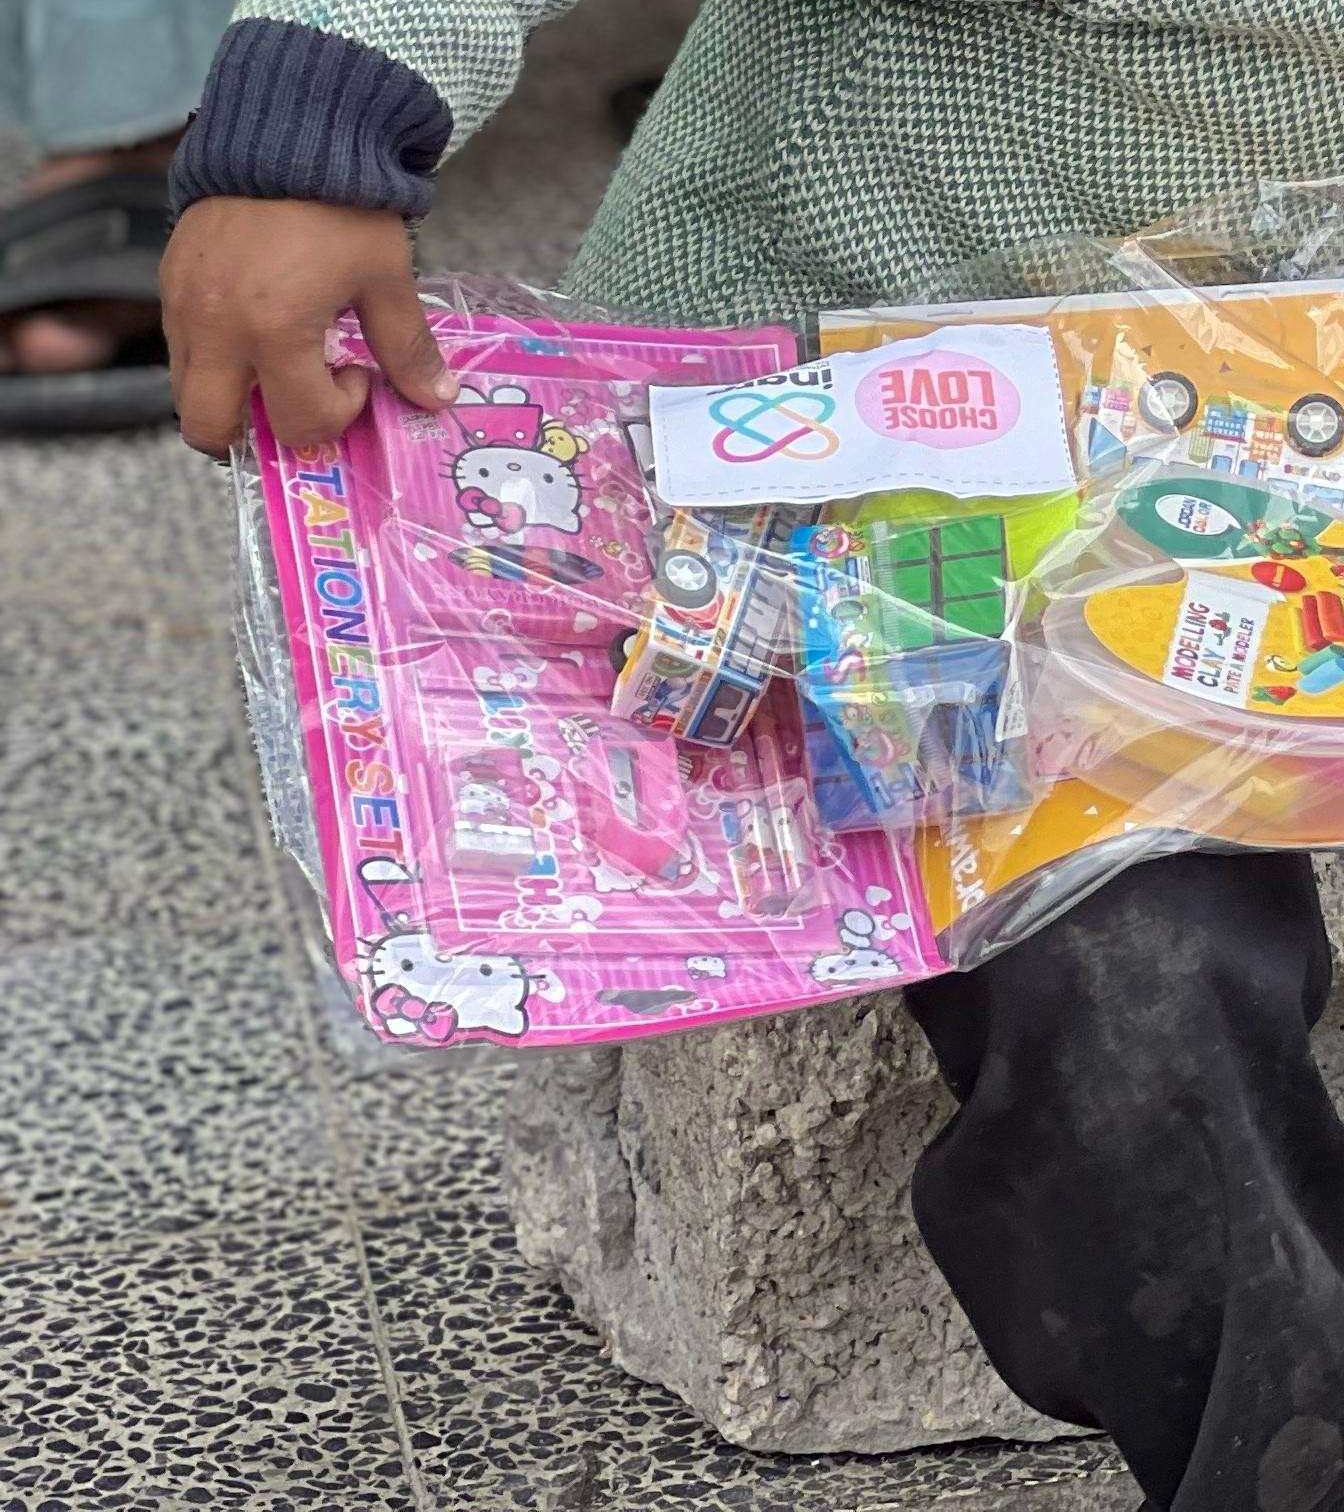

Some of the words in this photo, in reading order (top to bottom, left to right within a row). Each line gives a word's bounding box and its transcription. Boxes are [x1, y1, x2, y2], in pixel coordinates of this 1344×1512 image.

[878, 368, 997, 407] LOVE
[885, 405, 999, 431] CHOOSE
[292, 441, 390, 750] STATIONERY
[344, 758, 406, 865] SET
[1170, 601, 1211, 682] MODELLING
[1196, 647, 1226, 688] CLAY
